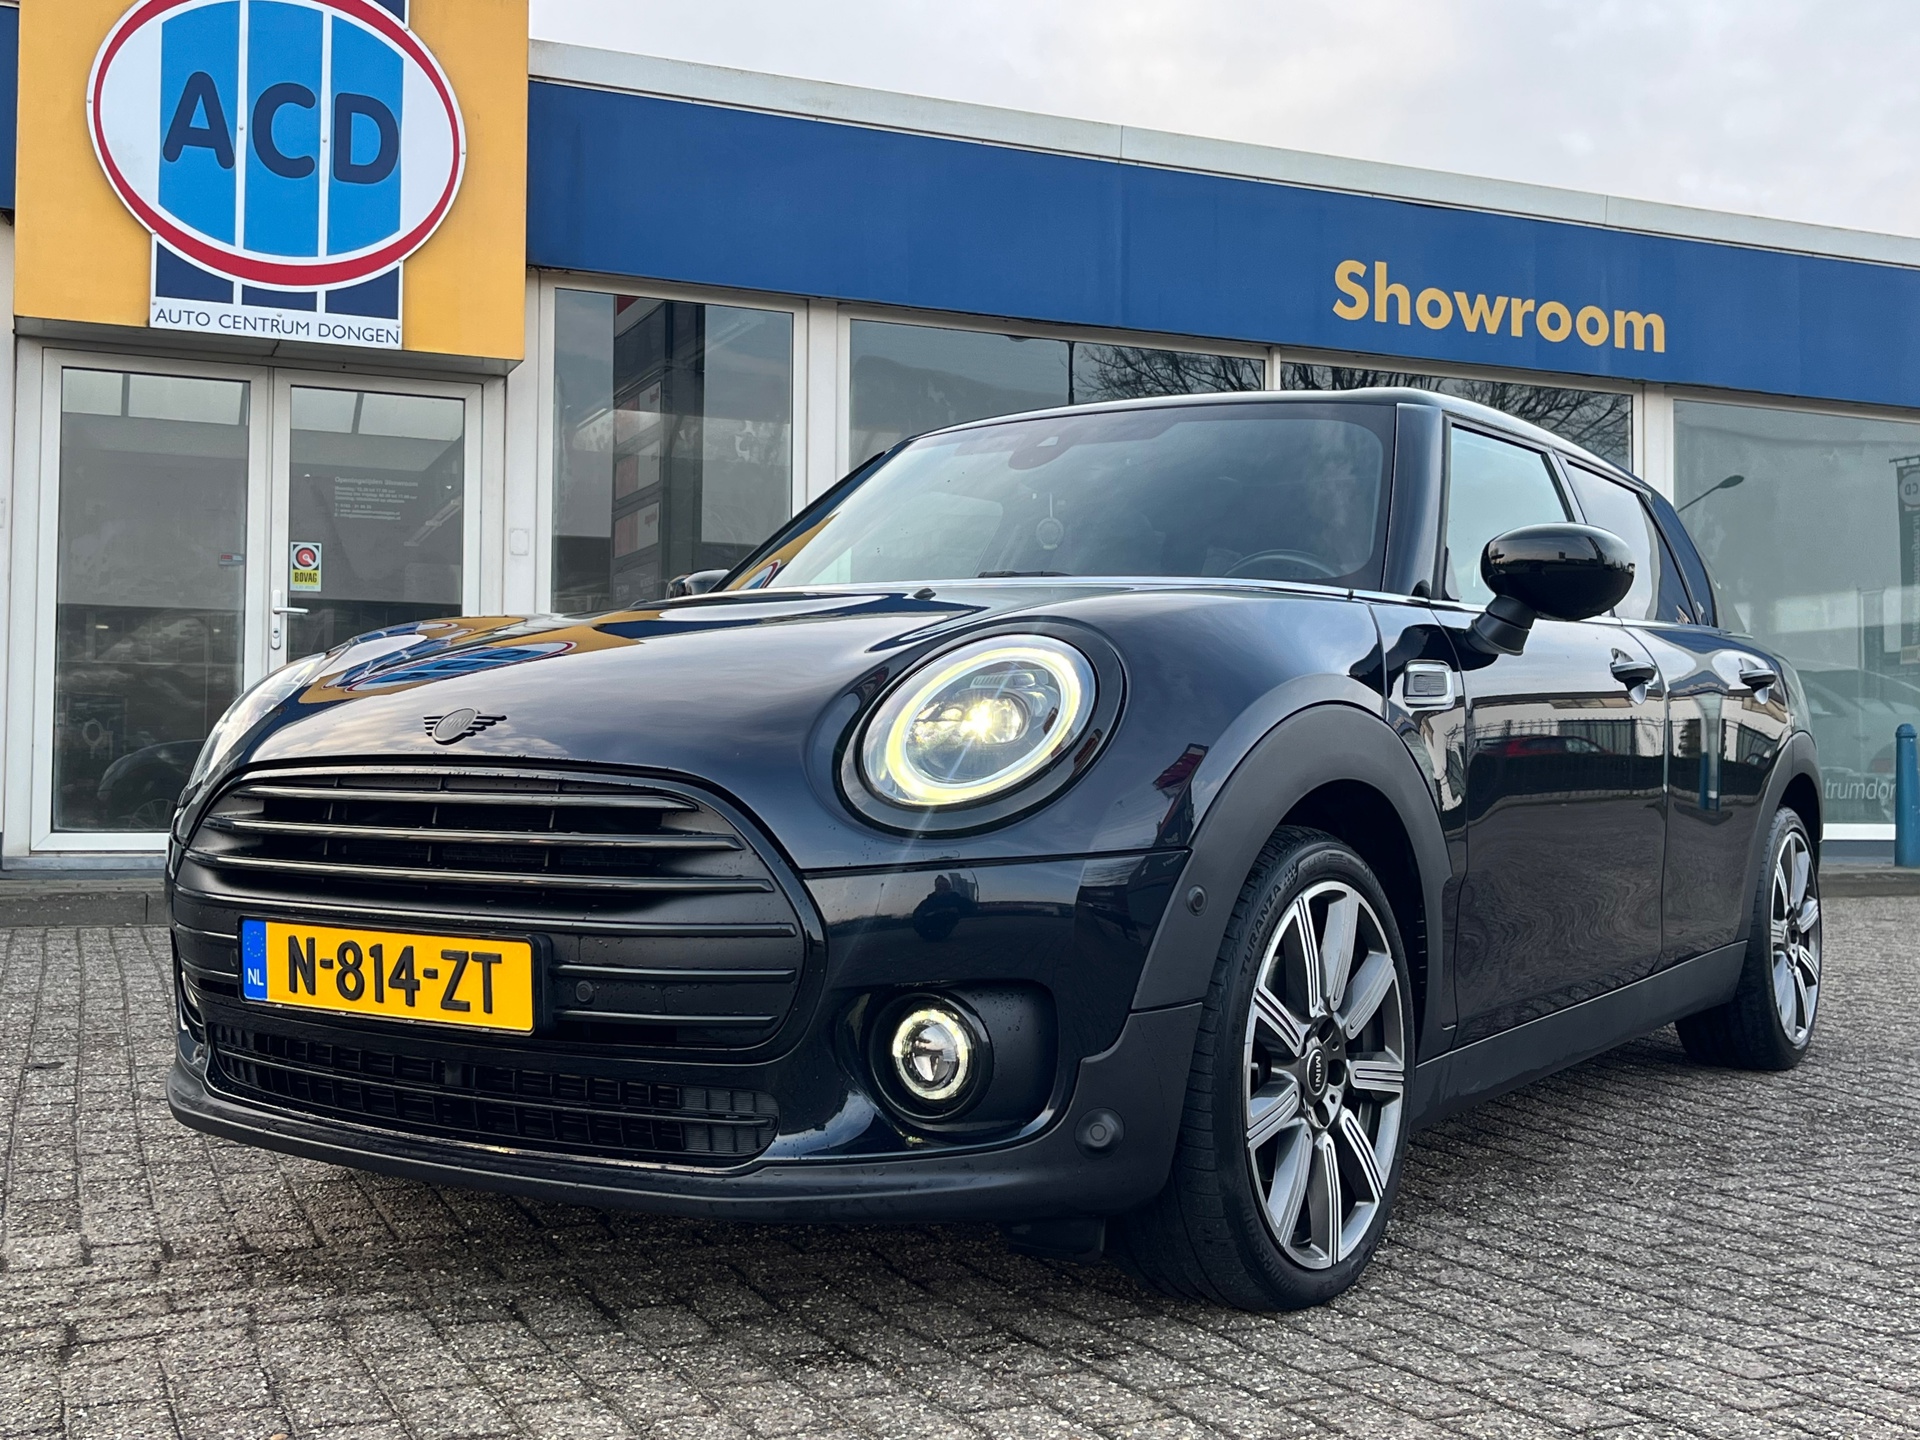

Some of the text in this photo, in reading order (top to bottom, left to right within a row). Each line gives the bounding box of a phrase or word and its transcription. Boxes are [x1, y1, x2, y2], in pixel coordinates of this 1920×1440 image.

[162, 71, 399, 185] ACD
[155, 308, 400, 344] AUTO CENTRUM DONGEN
[1332, 259, 1666, 353] Showroom
[294, 572, 317, 583] BOVAG
[1239, 884, 1281, 977] TURANZA
[247, 967, 264, 986] NL
[288, 935, 502, 1014] N-814-ZT
[1314, 1055, 1322, 1088] MINI
